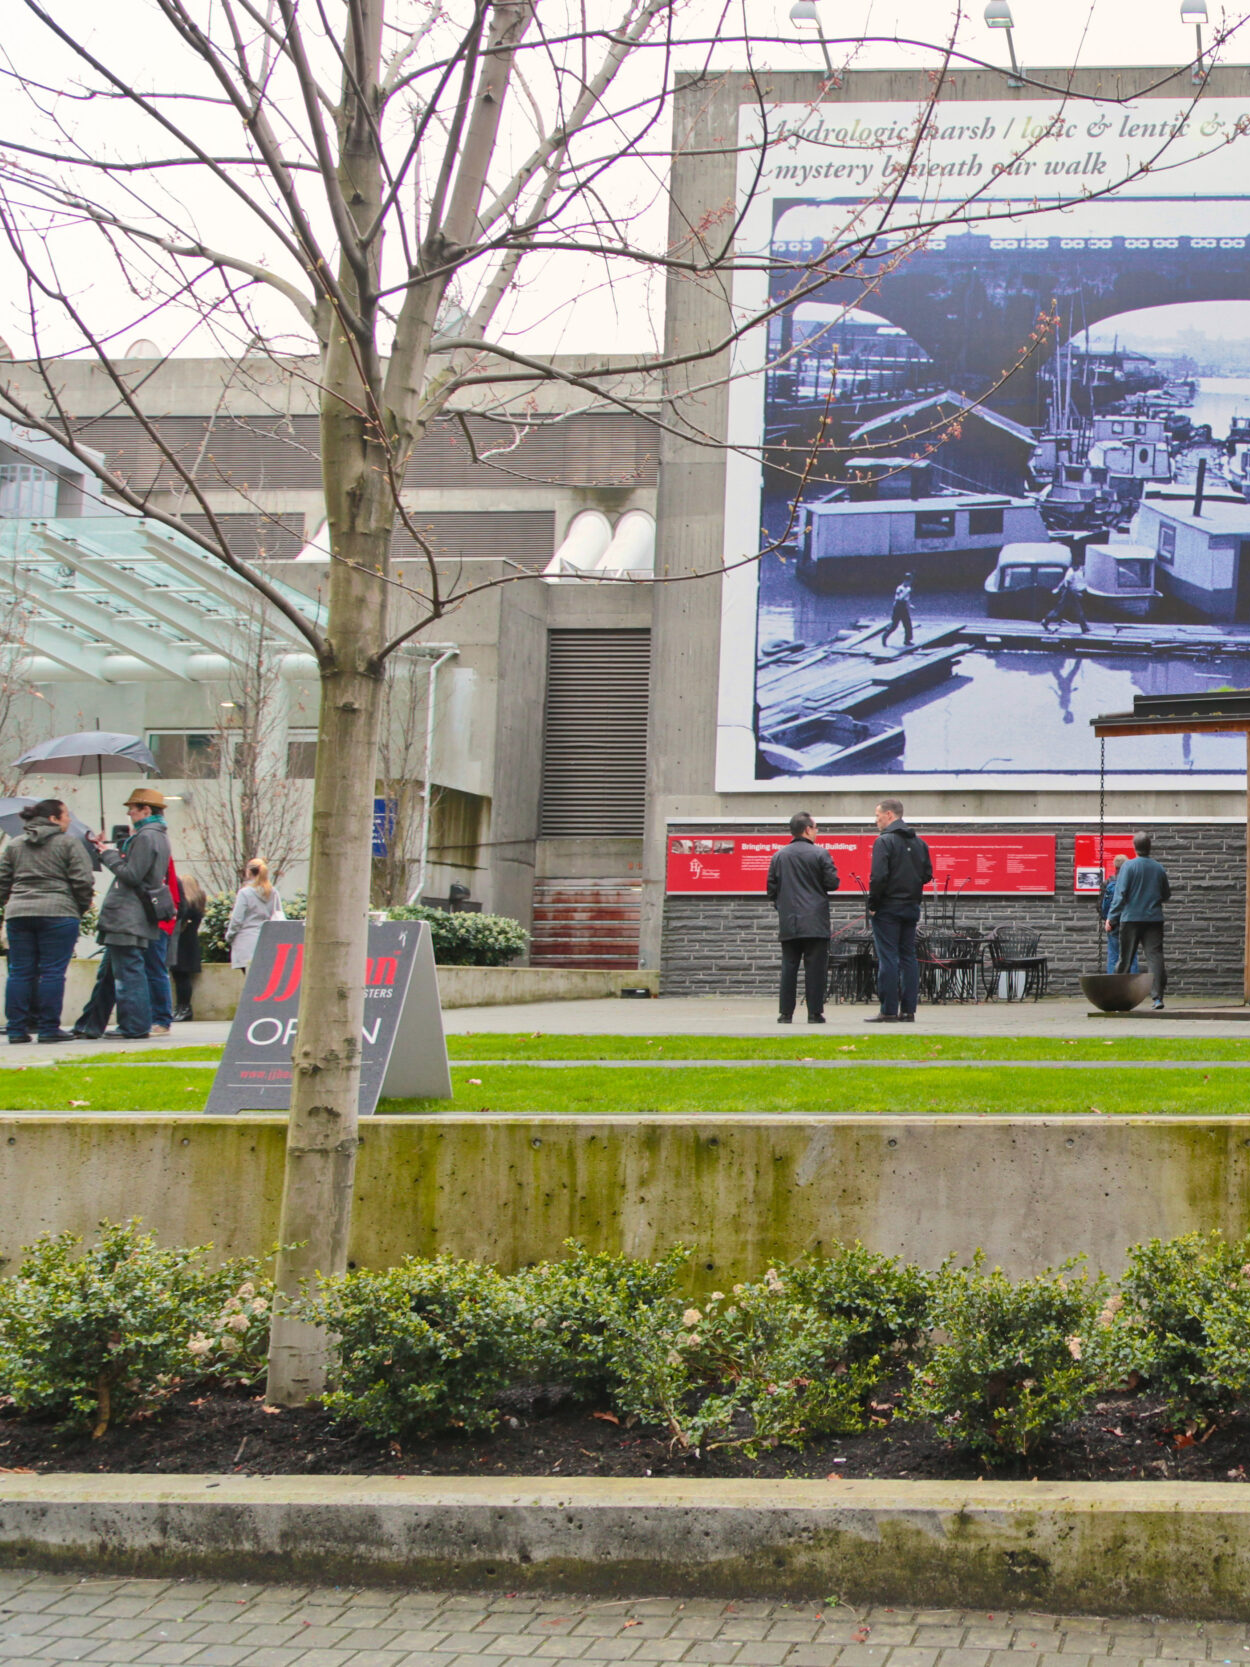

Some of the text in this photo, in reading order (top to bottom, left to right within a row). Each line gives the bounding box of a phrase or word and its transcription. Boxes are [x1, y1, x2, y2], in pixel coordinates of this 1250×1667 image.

[1086, 115, 1112, 138] &
[1119, 115, 1190, 137] lentic
[1200, 112, 1225, 136] &
[775, 152, 1107, 187] mystery bneath our walk
[741, 843, 770, 851] Bringing
[826, 843, 857, 851] Buildings
[363, 988, 393, 999] STERS
[246, 1017, 382, 1046] OPN
